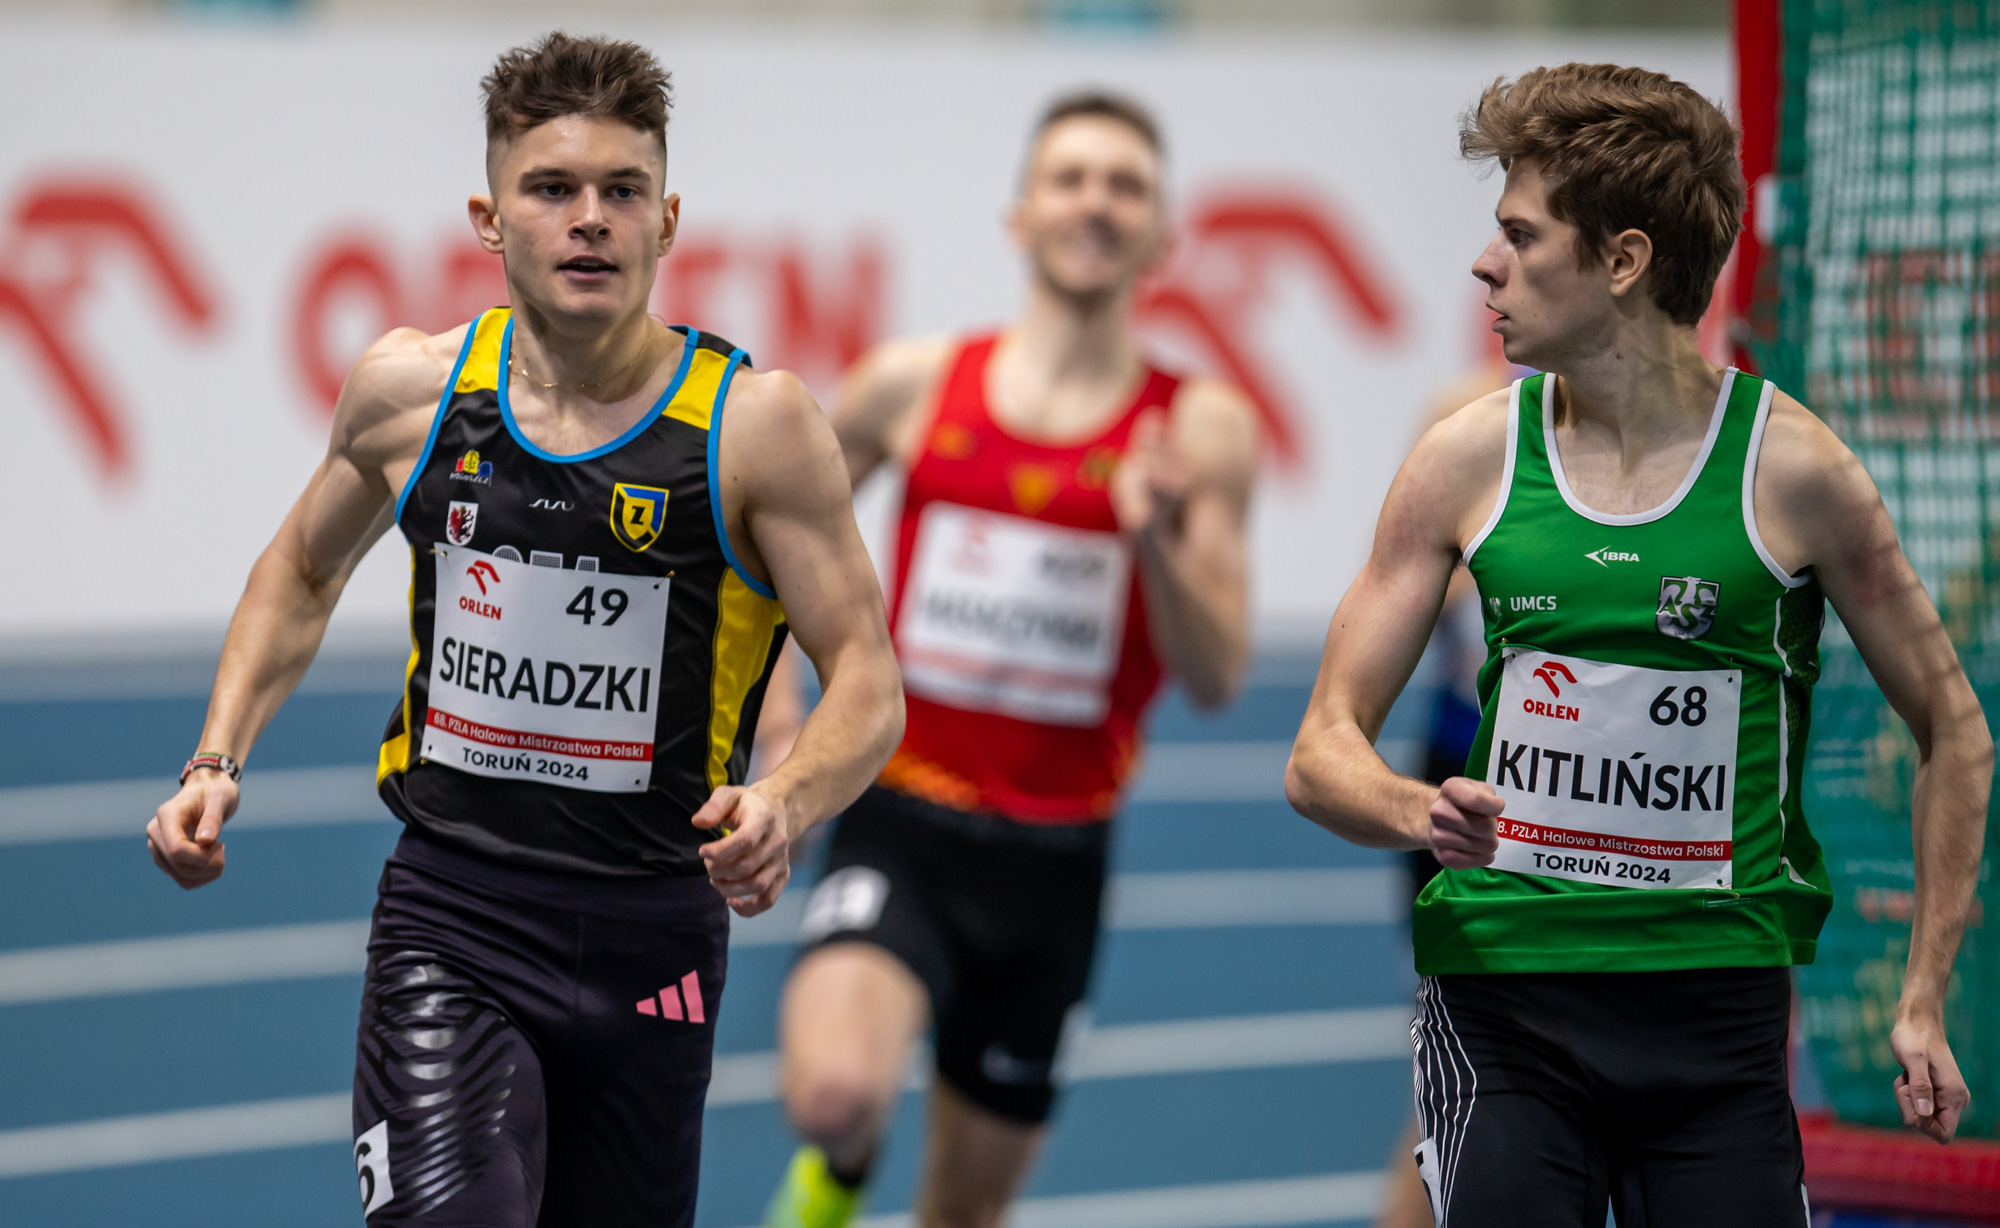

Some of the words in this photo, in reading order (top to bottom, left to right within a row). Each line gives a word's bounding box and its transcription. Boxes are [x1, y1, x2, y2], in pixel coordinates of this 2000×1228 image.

[629, 505, 646, 525] Z
[459, 596, 502, 620] ORLEN
[565, 585, 629, 626] 49
[1510, 596, 1557, 611] UMCS
[439, 636, 651, 712] SIERADZKI
[1523, 698, 1579, 721] ORLEN
[1649, 686, 1707, 726] 68
[433, 711, 447, 727] 68.
[448, 718, 469, 736] PZLA
[470, 725, 516, 745] Halowe
[519, 735, 601, 756] Mistrzostwa
[604, 743, 644, 758] Polski
[462, 746, 531, 772] TORUŃ
[536, 758, 589, 781] 2024
[1496, 739, 1726, 812] KITLIŃSKI
[1496, 820, 1508, 834] 8.
[1510, 824, 1540, 840] PZLA
[1543, 830, 1596, 847] Halowe
[1599, 837, 1683, 857] Mistrzostwa
[1686, 844, 1724, 857] Polski
[1533, 852, 1610, 876] TORUŃ
[1615, 862, 1671, 883] 2024
